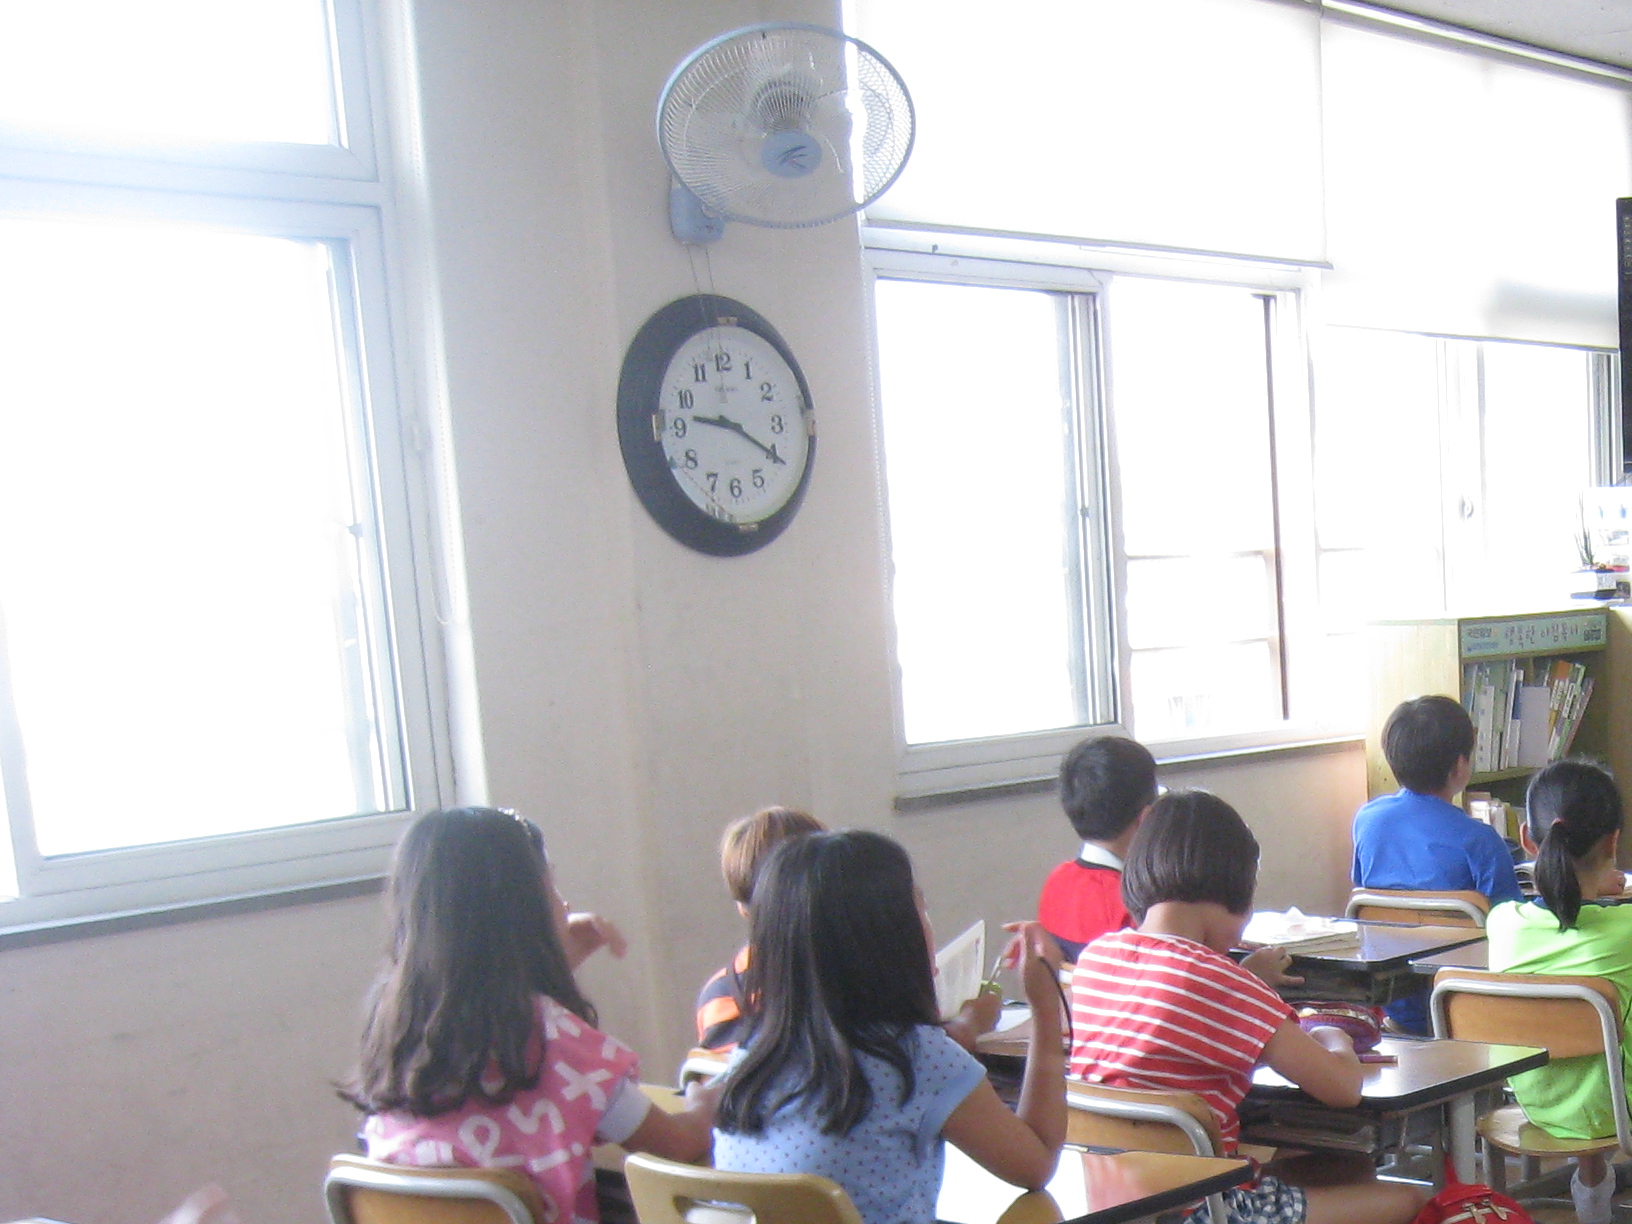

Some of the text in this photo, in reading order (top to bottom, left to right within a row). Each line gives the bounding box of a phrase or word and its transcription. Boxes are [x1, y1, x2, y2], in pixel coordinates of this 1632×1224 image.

[713, 352, 732, 372] 12
[744, 361, 751, 380] 1
[693, 363, 706, 383] 11
[678, 389, 694, 409] 10
[761, 382, 773, 401] 2
[673, 418, 687, 438] 9
[771, 414, 783, 434] 3
[684, 449, 698, 469] 8
[706, 473, 718, 493] 7
[729, 479, 742, 498] 6
[752, 469, 765, 488] 5
